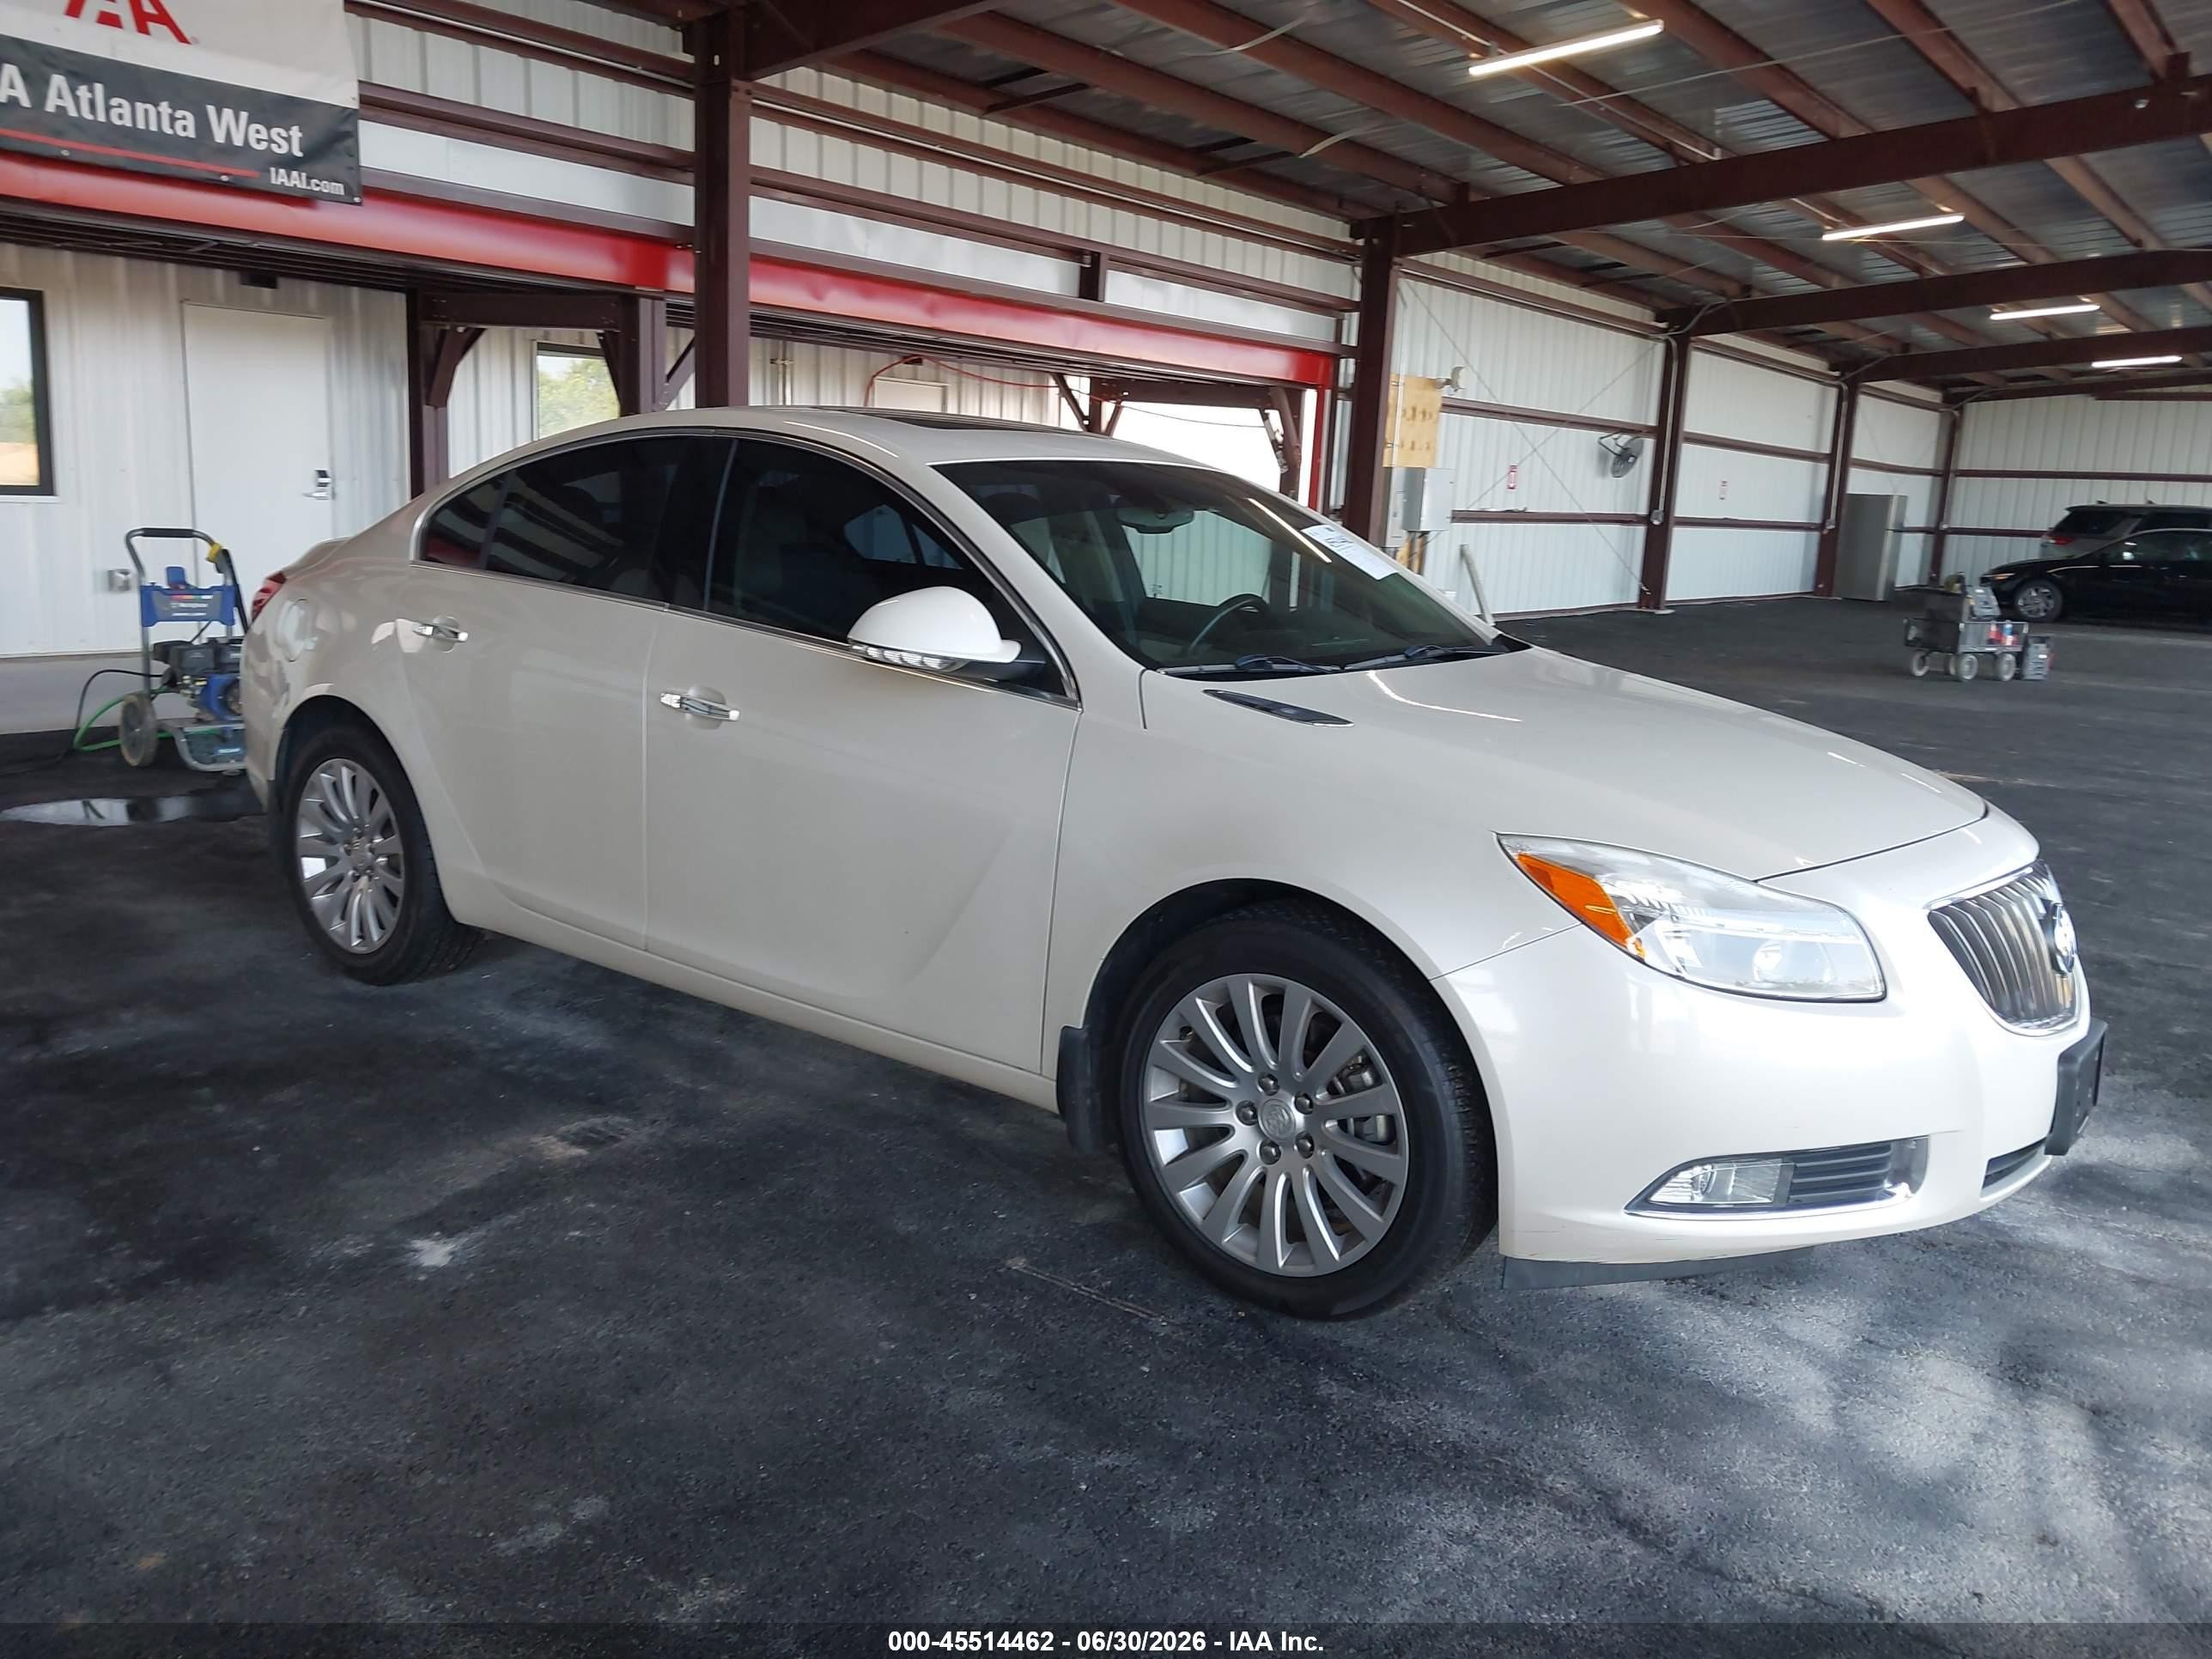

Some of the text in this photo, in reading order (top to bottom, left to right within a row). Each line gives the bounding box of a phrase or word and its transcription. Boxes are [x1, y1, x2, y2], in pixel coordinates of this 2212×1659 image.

[45, 74, 197, 139] Atlanta
[205, 104, 304, 157] West
[269, 167, 345, 196] IAAI.com
